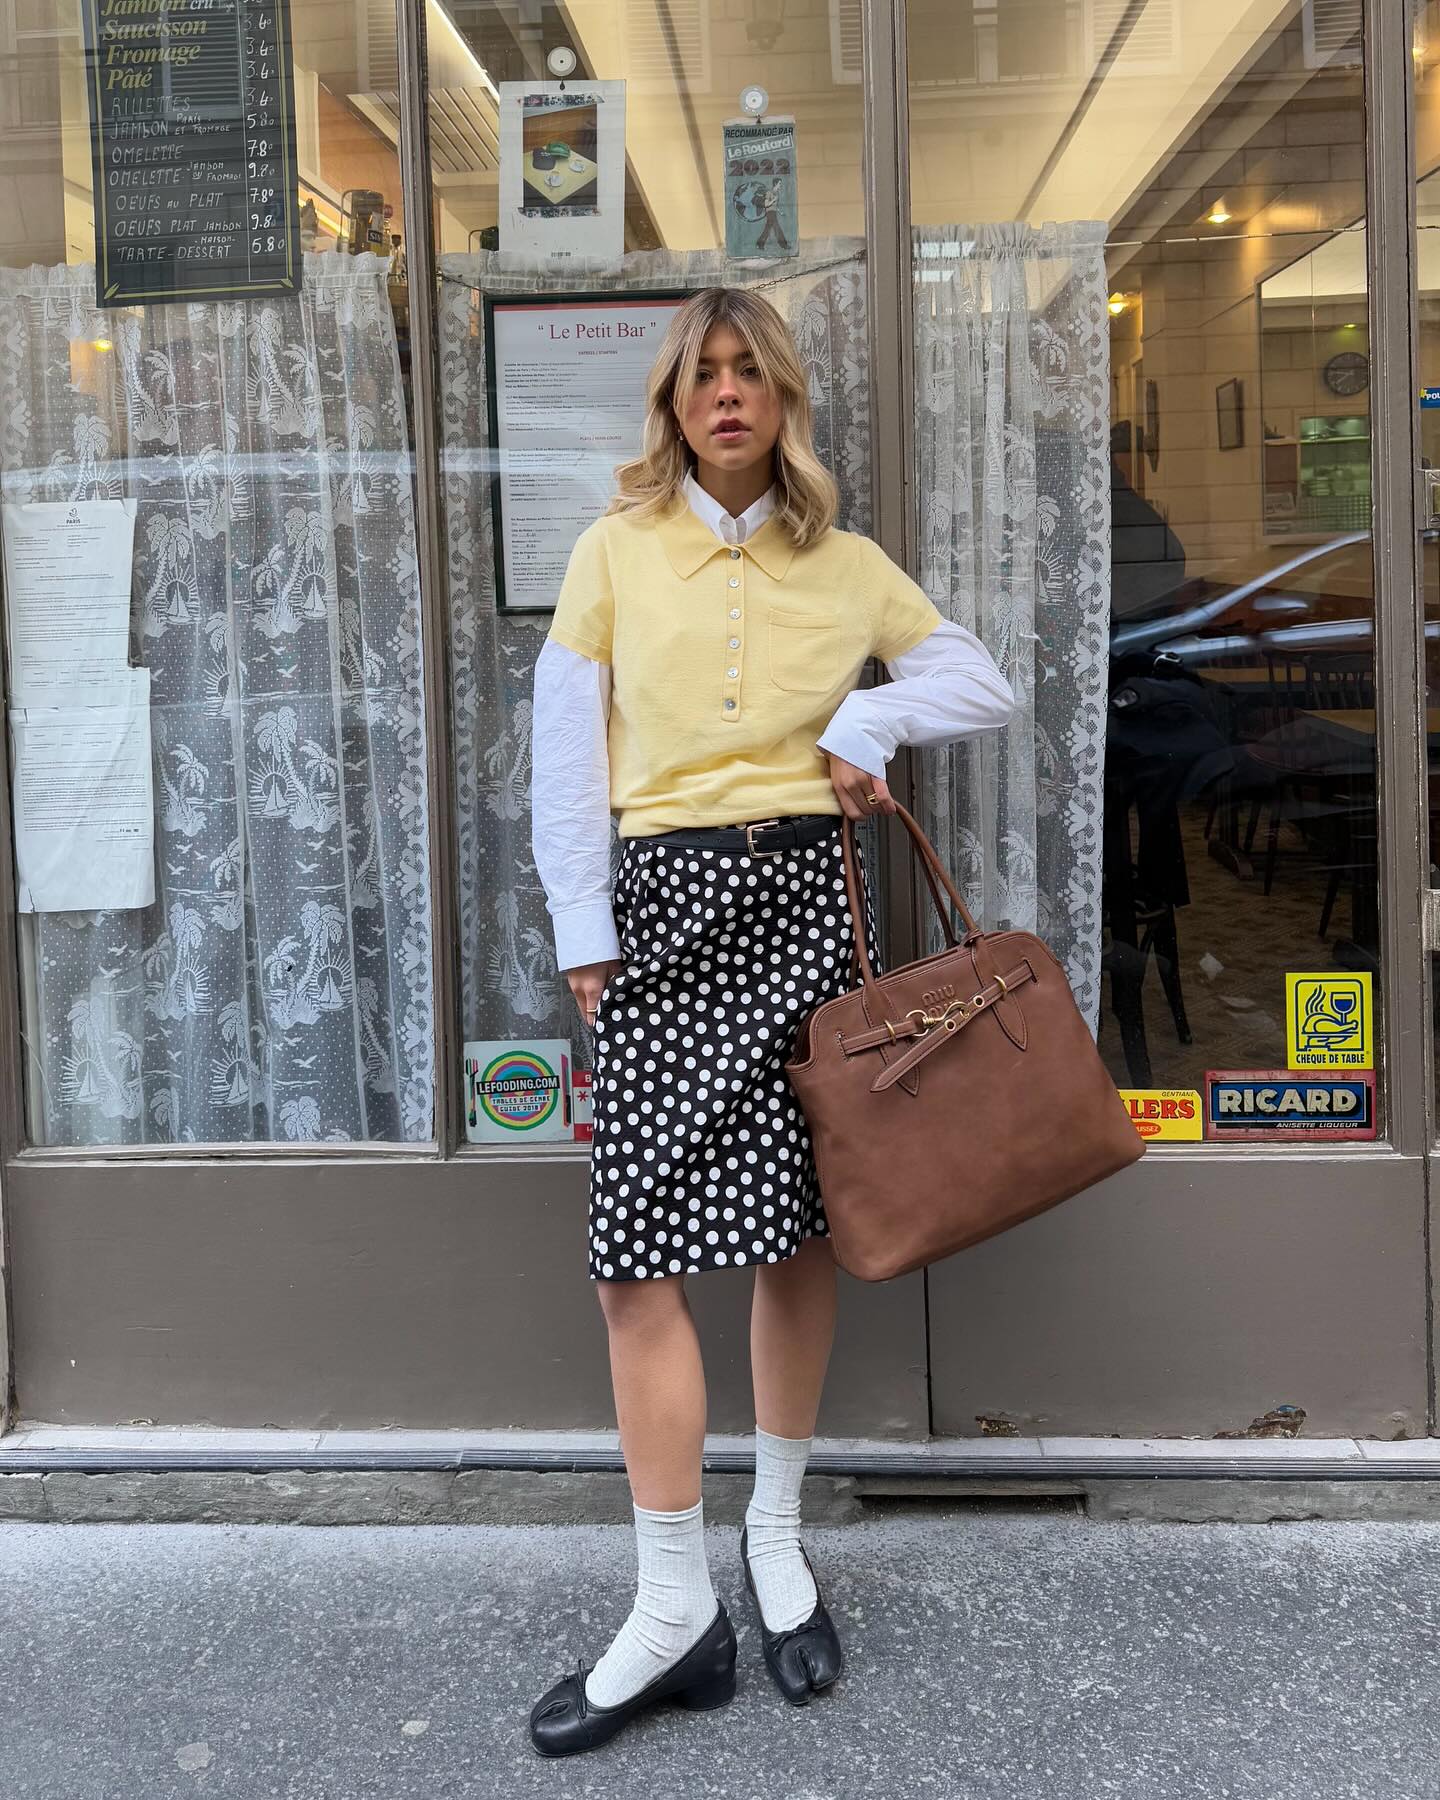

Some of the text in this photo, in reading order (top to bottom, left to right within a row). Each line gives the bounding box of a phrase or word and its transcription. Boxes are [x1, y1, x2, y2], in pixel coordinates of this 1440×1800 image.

[101, 0, 186, 16] Jambon
[103, 17, 208, 40] Saucisson
[105, 44, 201, 66] Fromage
[106, 67, 152, 90] Pâté
[111, 96, 190, 116] RILLETTES
[778, 127, 793, 135] PAR
[112, 144, 184, 163] OMELETTE
[728, 135, 790, 158] Le Routard
[728, 159, 790, 176] 2022
[109, 168, 182, 186] OMELETTE
[116, 192, 224, 210] OEUFS AU PLAT
[114, 219, 161, 237] OEUFS
[170, 220, 197, 233] PLAT
[117, 246, 167, 261] TARTE
[177, 245, 231, 259] DESSERT
[550, 324, 570, 340] Le
[576, 322, 611, 339] Petit
[617, 322, 646, 338] Bar
[1296, 1054, 1364, 1064] CHEQUE DE TABLE
[479, 1077, 558, 1093] LEFOODING.COM
[1123, 1099, 1195, 1119] LERS
[1218, 1088, 1357, 1113] RICARD
